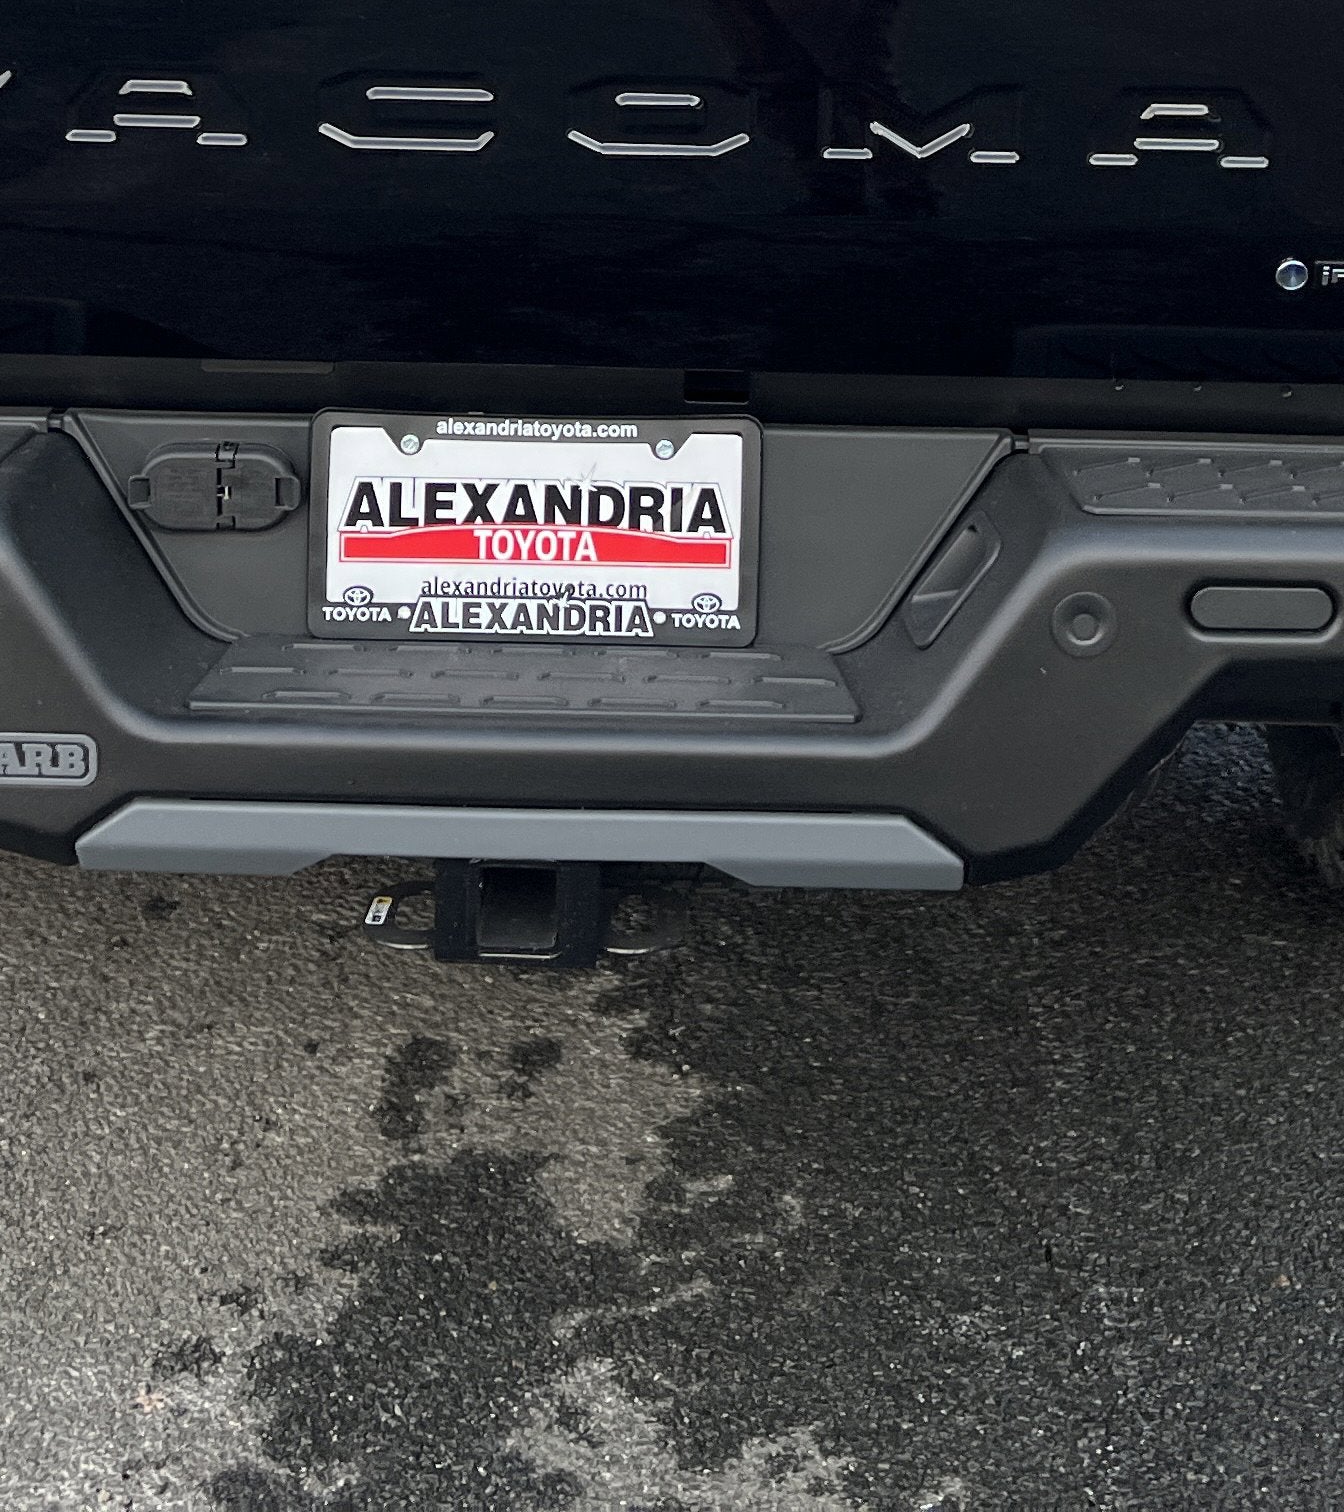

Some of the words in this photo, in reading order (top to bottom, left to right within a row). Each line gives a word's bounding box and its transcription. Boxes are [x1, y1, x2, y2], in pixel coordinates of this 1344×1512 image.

[435, 419, 639, 441] alexandriatoyota.com
[344, 481, 727, 533] ALEXANDRIA
[472, 528, 599, 562] TOYOTA
[420, 575, 648, 599] alexandriatoyota.com
[321, 606, 393, 624] TOYOTA
[410, 597, 654, 636] ALEXANDRIA
[670, 612, 742, 631] TOYOTA
